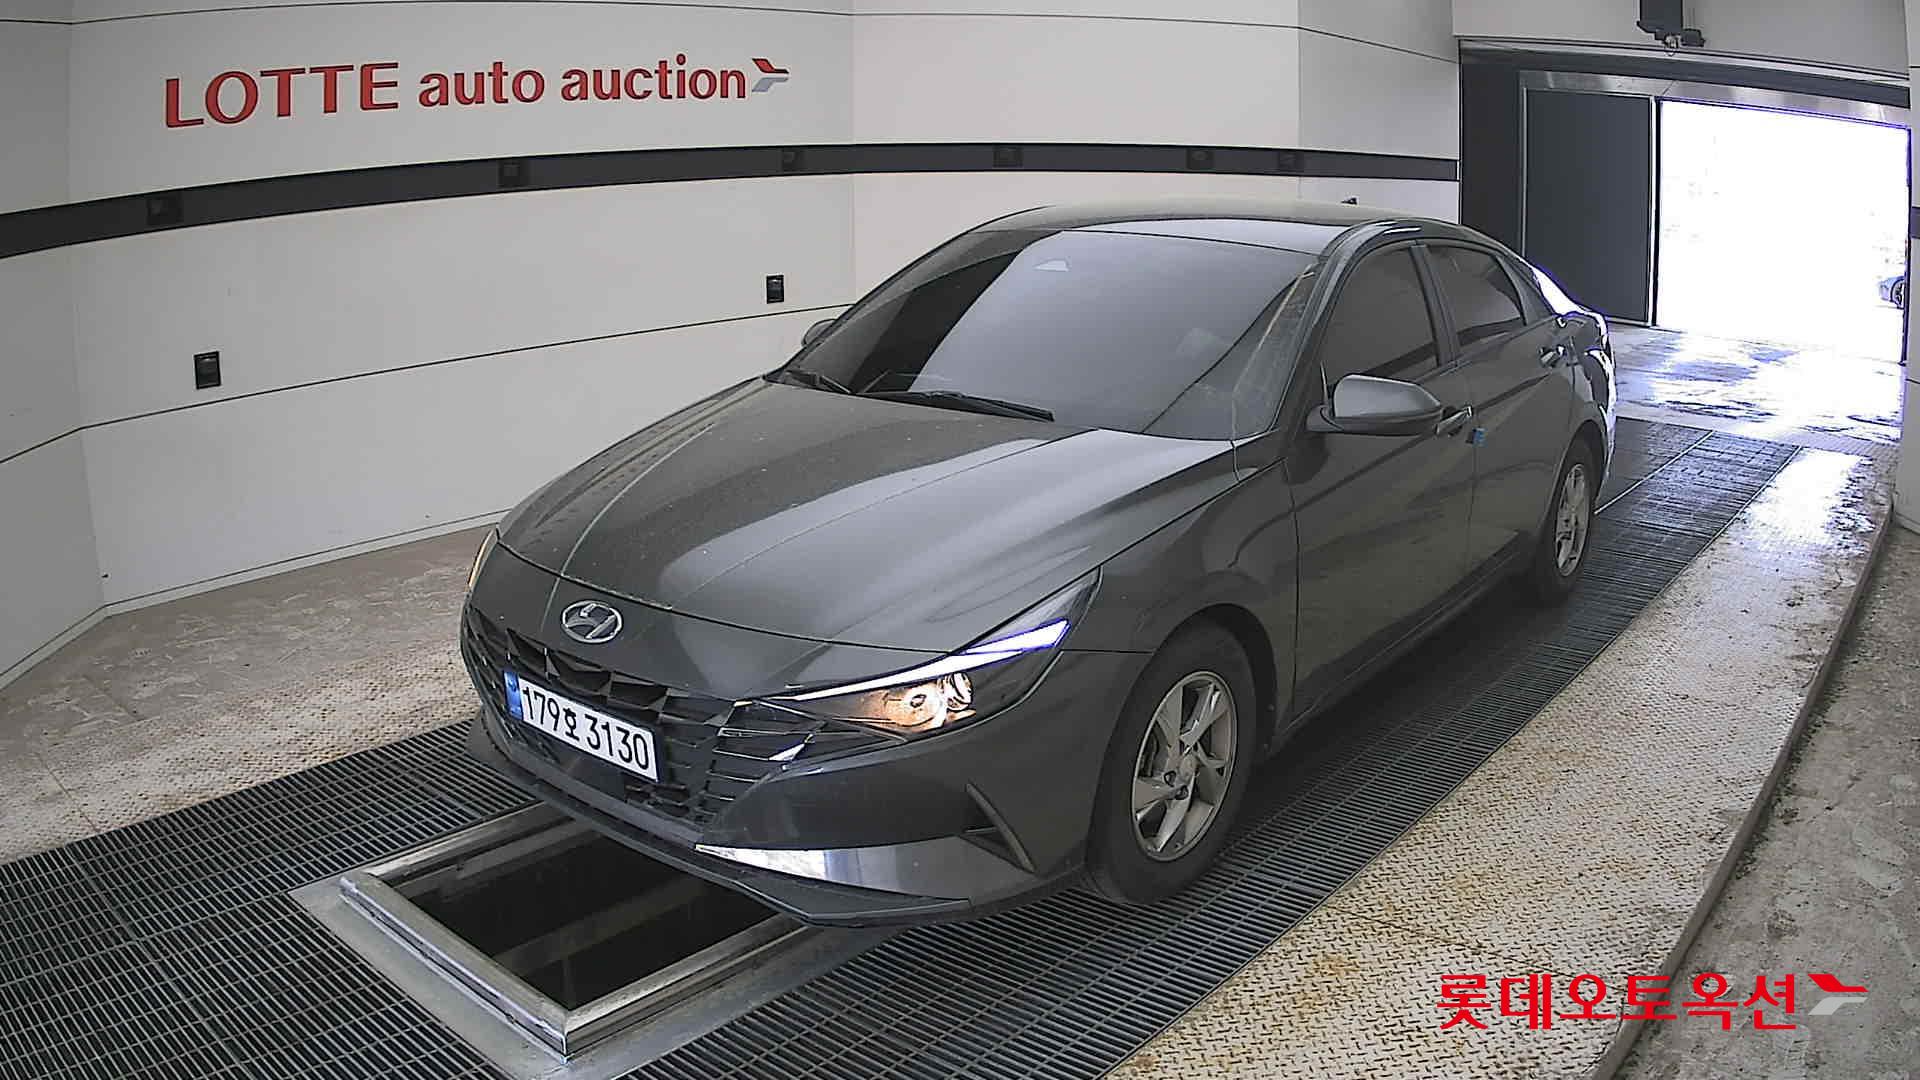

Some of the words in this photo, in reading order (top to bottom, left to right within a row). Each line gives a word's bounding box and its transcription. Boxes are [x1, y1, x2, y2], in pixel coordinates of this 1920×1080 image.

[165, 62, 400, 128] LOTTE
[418, 61, 546, 108] auto
[560, 53, 748, 101] auction
